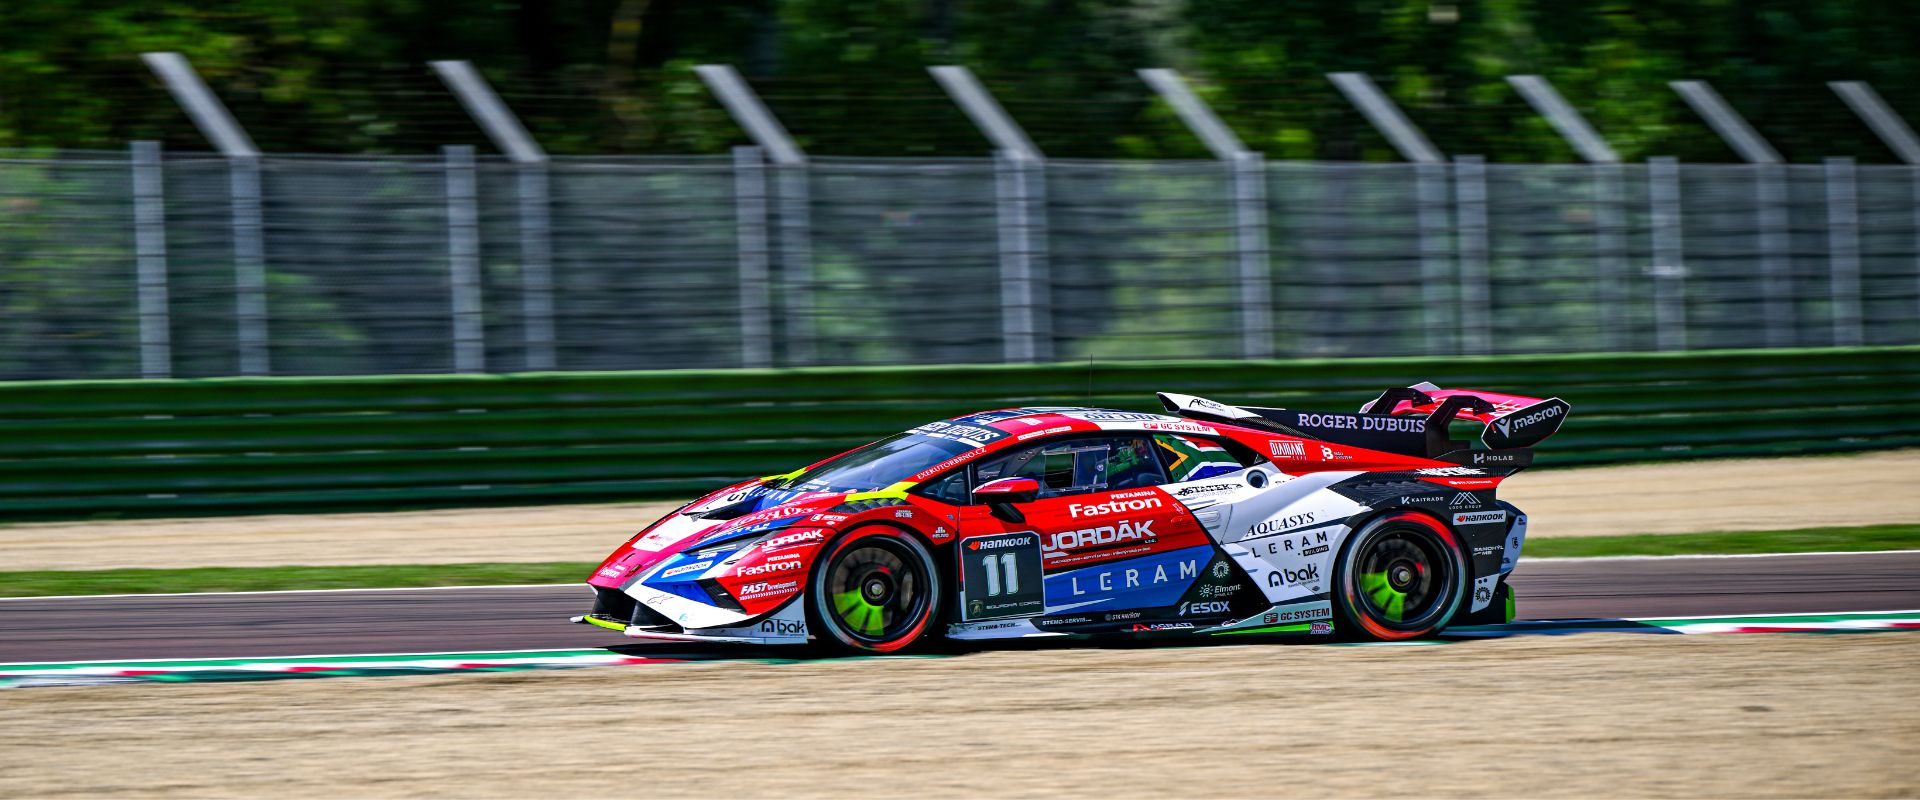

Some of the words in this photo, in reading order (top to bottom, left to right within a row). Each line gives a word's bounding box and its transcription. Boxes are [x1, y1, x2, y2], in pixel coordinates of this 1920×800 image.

[1297, 413, 1361, 430] ROGER
[1363, 417, 1427, 433] DUBUIS
[1514, 405, 1563, 430] macron
[1174, 424, 1211, 432] SYSTEM
[916, 447, 987, 480] EXEKUTORBRNO.CZ
[1110, 490, 1157, 500] PERTAMINA
[1069, 498, 1163, 518] Fastron
[1246, 512, 1315, 537] AQUASYS
[1252, 531, 1328, 558] LERAM
[767, 553, 801, 563] PERTAMINA
[736, 561, 803, 577] Fastron
[982, 553, 1019, 596] 11
[1072, 560, 1197, 596] LERAM
[740, 582, 768, 595] FAST
[1213, 584, 1243, 595] Elmont
[1190, 601, 1232, 614] ESOX
[1281, 612, 1292, 620] GC
[1294, 608, 1330, 620] SYSTEM
[1310, 624, 1331, 632] BMC
